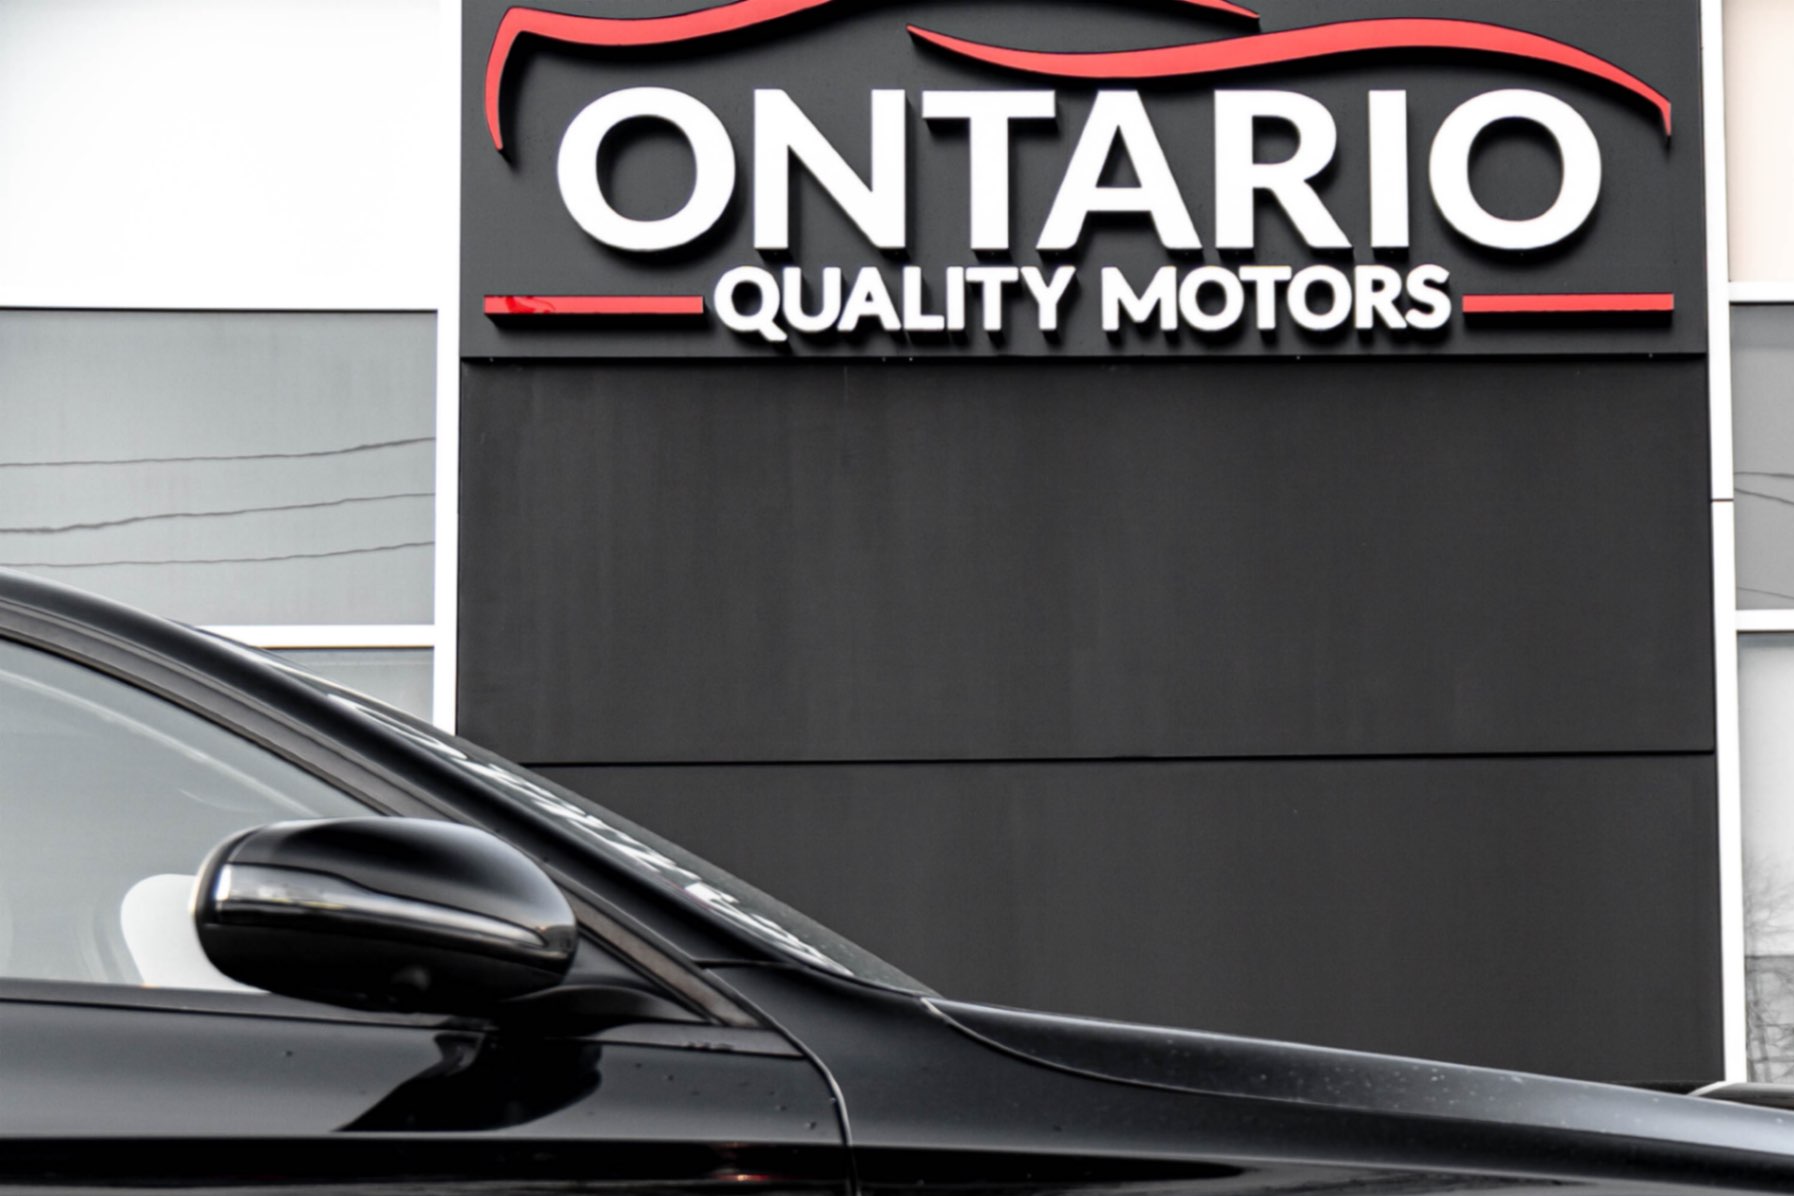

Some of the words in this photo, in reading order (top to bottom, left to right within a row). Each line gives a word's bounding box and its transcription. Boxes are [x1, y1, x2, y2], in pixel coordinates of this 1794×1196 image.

[557, 87, 1601, 250] ONTARIO
[714, 266, 1075, 341] QUALITY
[1101, 264, 1451, 330] MOTORS
